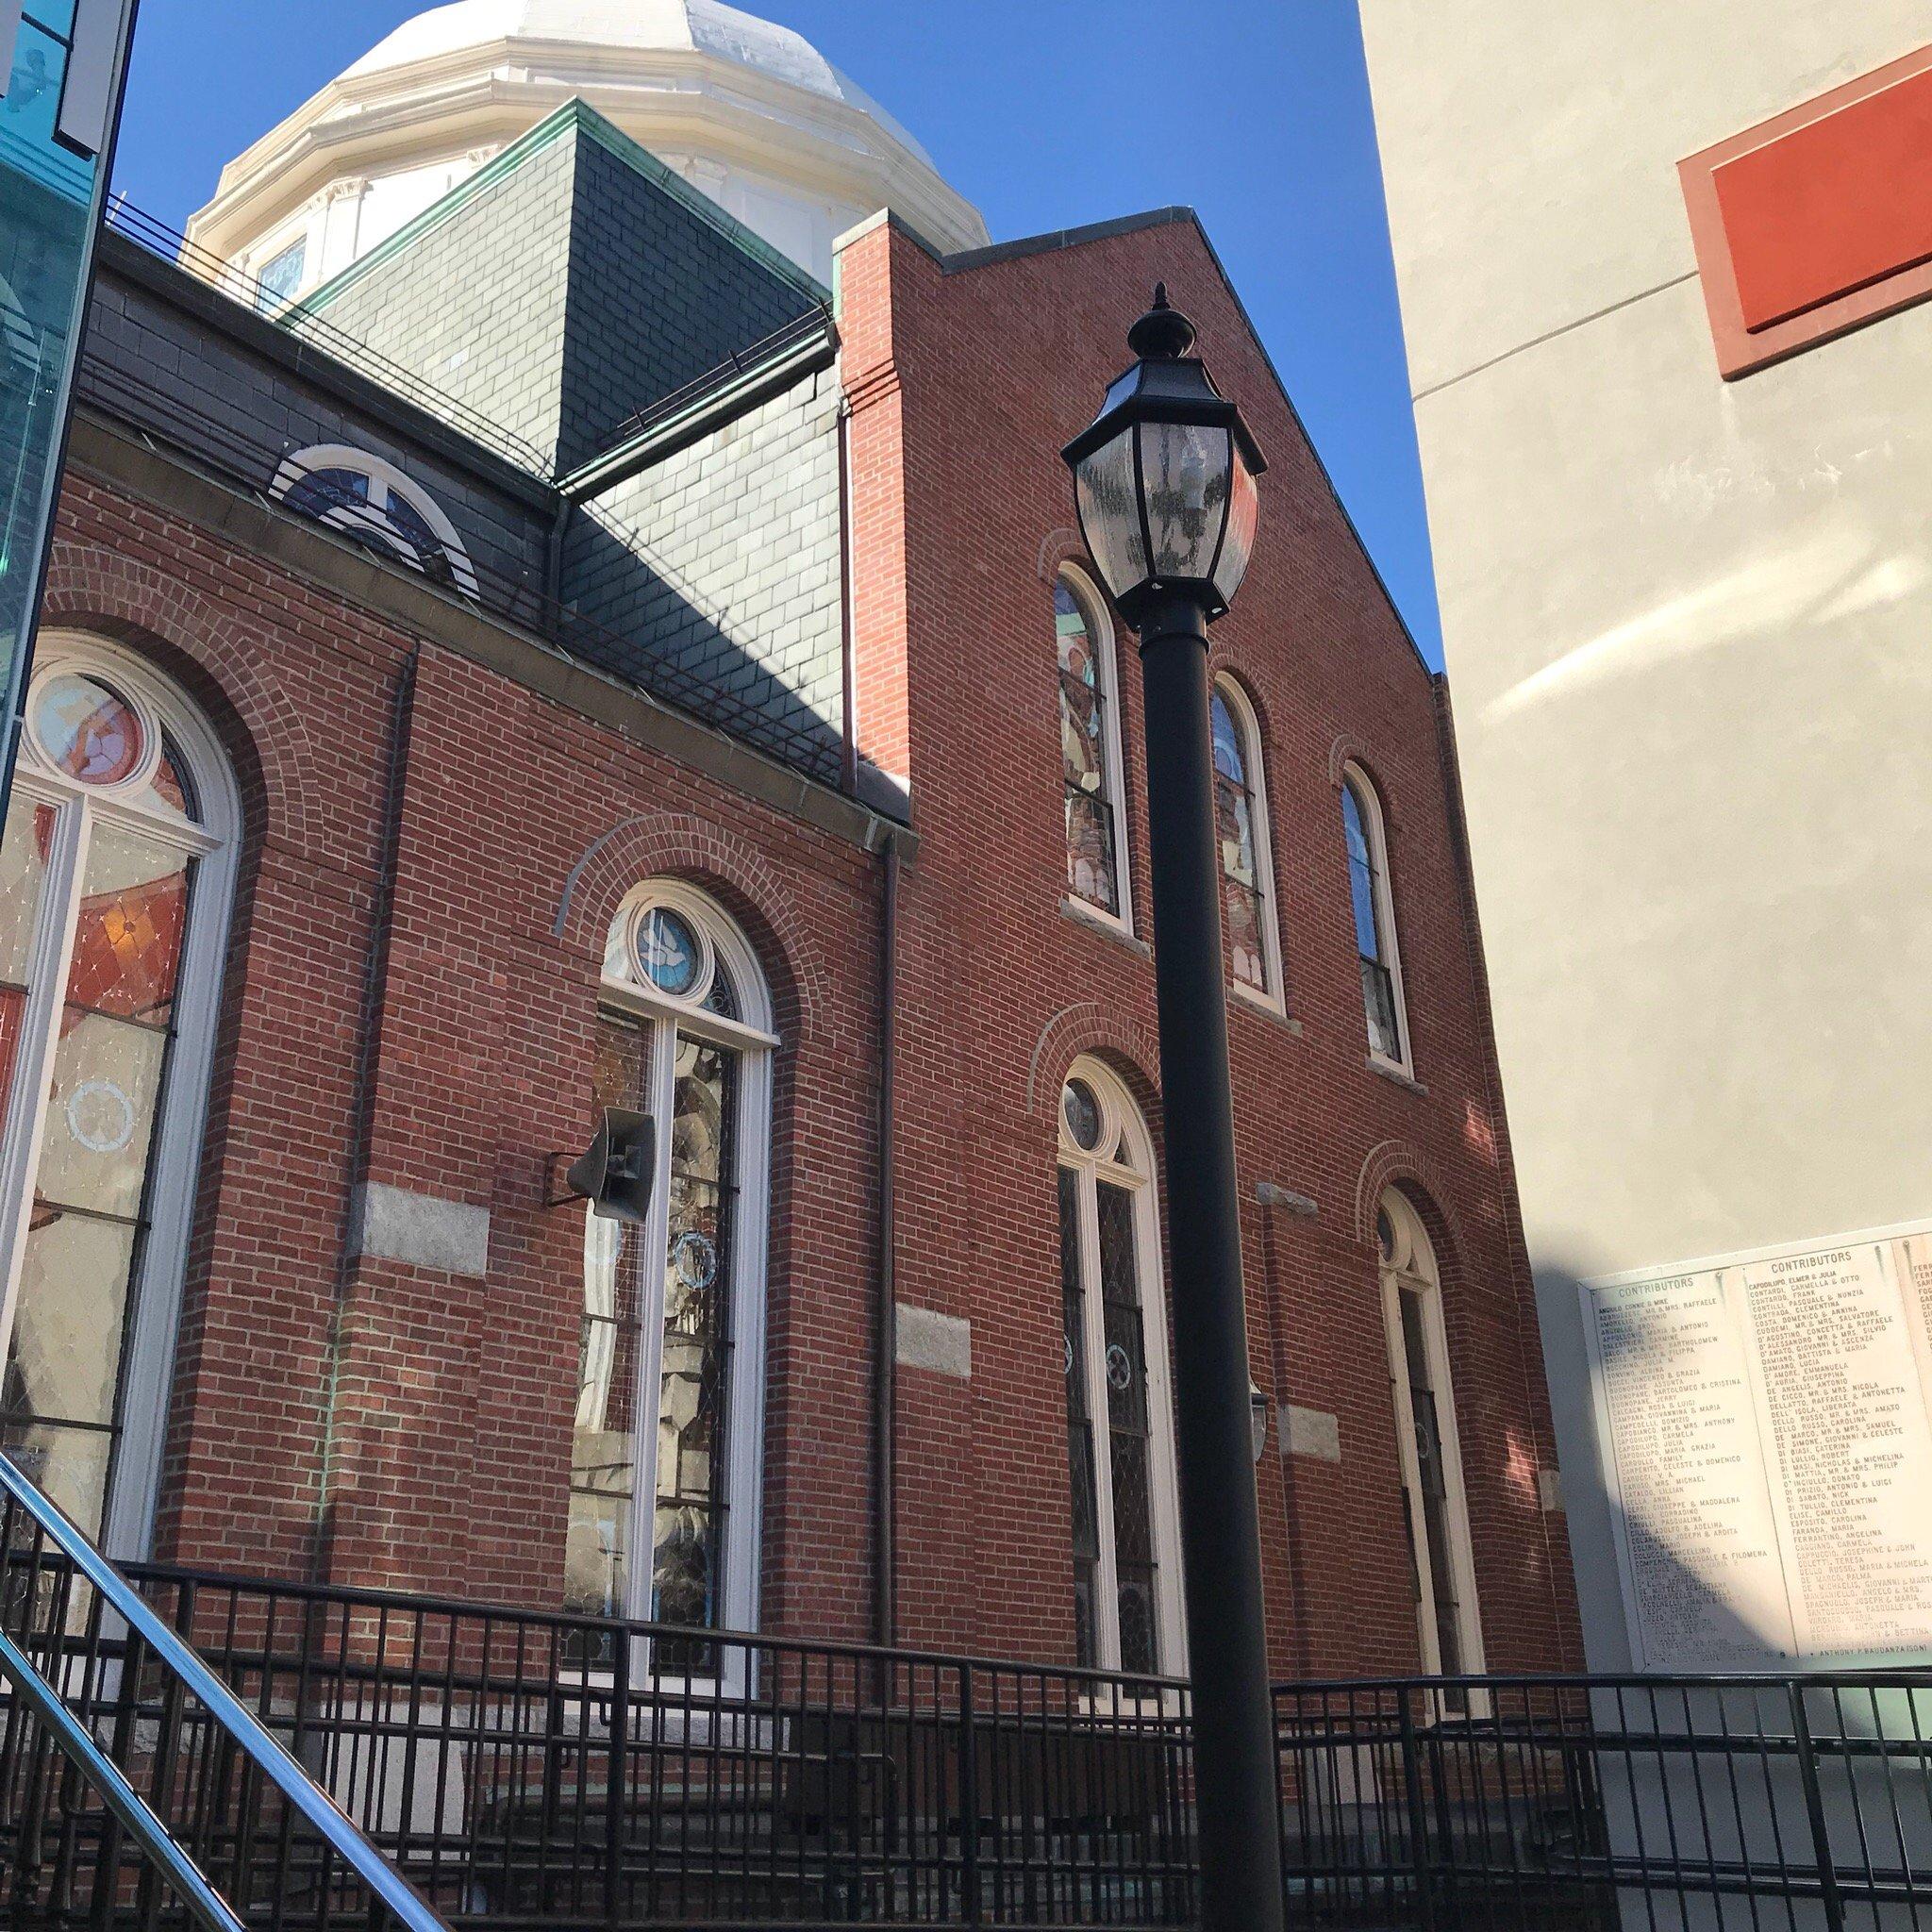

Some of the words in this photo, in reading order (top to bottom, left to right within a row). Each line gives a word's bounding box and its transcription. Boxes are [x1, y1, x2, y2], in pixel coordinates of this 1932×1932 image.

[1771, 1251, 1851, 1273] CONTRIBUTORS
[1840, 1275, 1859, 1283] OTTO
[1619, 1277, 1693, 1297] CONTRIBUTORS
[1793, 1290, 1815, 1298] FRANK
[1684, 1298, 1716, 1308] RAFFAELE
[1789, 1296, 1824, 1306] PASQUALE
[1795, 1301, 1839, 1313] CLEMENTINA
[1782, 1312, 1818, 1322] DOMENICO
[1839, 1310, 1879, 1321] SALVATORE
[1680, 1321, 1708, 1331] ANTONIO
[1807, 1324, 1843, 1335] CONCETTA
[1857, 1316, 1892, 1327] RAFFAELE
[1863, 1325, 1886, 1333] SILVIO
[1797, 1342, 1828, 1352] GIOVANNI
[1798, 1349, 1831, 1359] BATTISTA
[1800, 1359, 1819, 1367] LUCIA
[1804, 1362, 1848, 1374] EMMANUELA
[1676, 1369, 1700, 1377] GRAZIA
[1802, 1370, 1844, 1381] GIUSEPPINA
[1710, 1378, 1741, 1387] CRISTINA
[1817, 1378, 1847, 1387] ANTONIO
[1852, 1382, 1878, 1391] NICOLA
[1812, 1394, 1847, 1404] RAFFAELE
[1861, 1386, 1905, 1397] ANTONETTA
[1822, 1401, 1856, 1411] LIBERATA
[1875, 1404, 1900, 1412] AMATO
[1704, 1417, 1735, 1426] ANTHONY
[1831, 1416, 1865, 1426] CAROLINA
[1866, 1420, 1895, 1429] SAMUEL
[1663, 1430, 1694, 1439] CARMELA
[1825, 1433, 1858, 1442] GIOVANNI
[1870, 1428, 1903, 1437] CELESTE
[1815, 1442, 1850, 1452] CATERINA
[1815, 1459, 1850, 1468] NICHOLAS
[1864, 1452, 1904, 1462] MICHELINA
[1821, 1451, 1849, 1459] ROBERT
[1664, 1461, 1692, 1470] CELESTE
[1706, 1456, 1740, 1465] DOMENICO
[1676, 1476, 1706, 1484] MICHAEL
[1832, 1474, 1859, 1482] DONATO
[1826, 1482, 1858, 1491] ANTONIO
[1700, 1496, 1740, 1506] MADDALENA
[1831, 1497, 1877, 1507] CLEMENTINA
[1816, 1508, 1846, 1516] CAMILLO
[1831, 1514, 1866, 1523] CAROLINA
[1846, 1530, 1882, 1538] ANGELINA
[1837, 1539, 1872, 1547] CARMELA
[1732, 1550, 1767, 1558] FILOMENA
